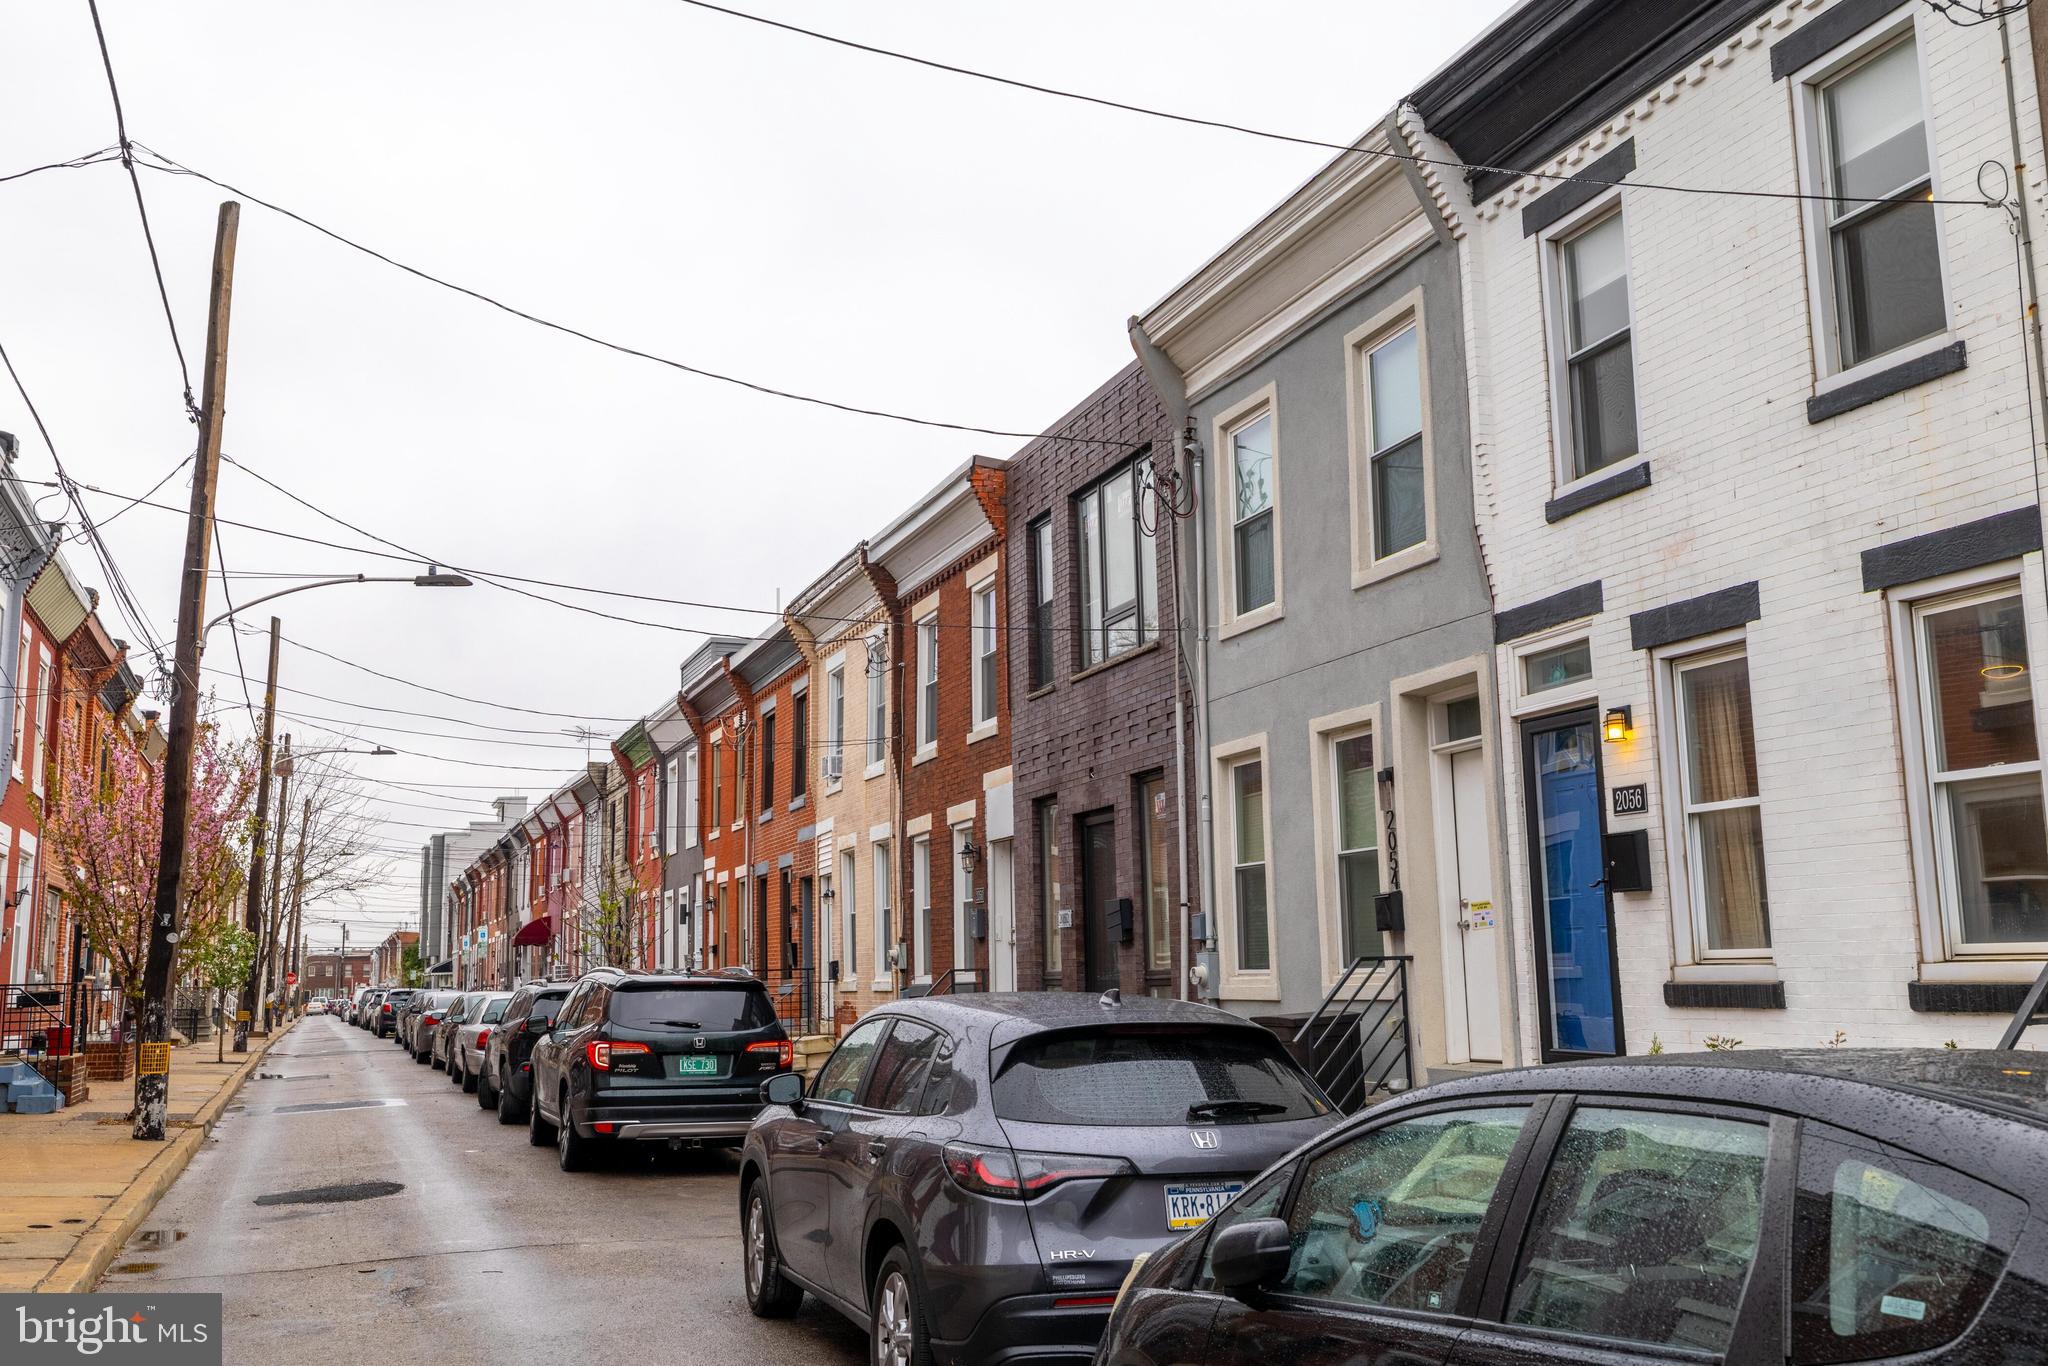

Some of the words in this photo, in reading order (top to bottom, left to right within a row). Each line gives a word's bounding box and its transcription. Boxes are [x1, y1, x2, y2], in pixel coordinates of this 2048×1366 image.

[1615, 788, 1643, 811] 2056
[1386, 810, 1399, 890] 2054
[1185, 1186, 1226, 1194] PENNSYLVANIA
[1171, 1196, 1200, 1217] KRK
[1050, 1249, 1096, 1260] HR-V
